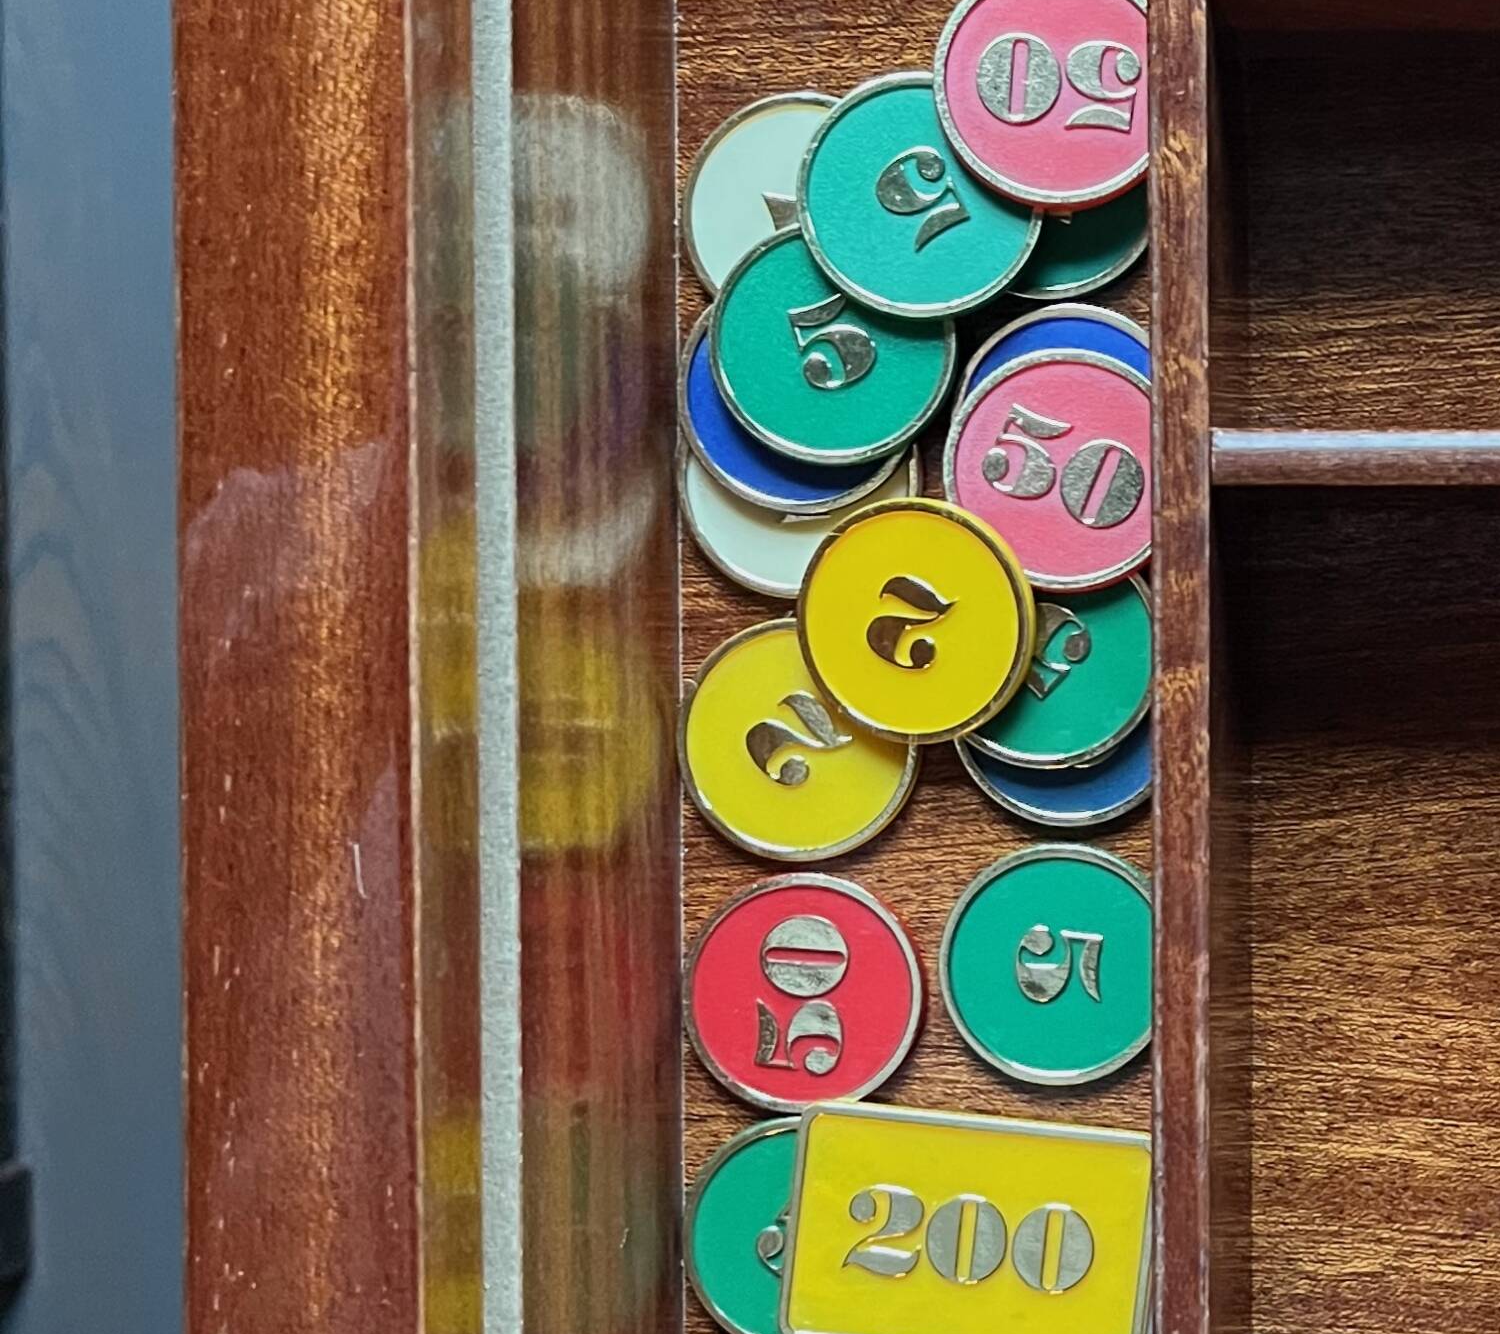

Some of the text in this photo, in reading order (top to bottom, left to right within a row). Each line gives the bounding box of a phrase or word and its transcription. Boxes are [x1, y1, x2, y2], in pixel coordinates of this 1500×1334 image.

[977, 32, 1141, 134] 50
[876, 145, 970, 253] 5
[788, 294, 877, 390] 5
[983, 403, 1145, 529] 50
[866, 575, 959, 670] 2
[745, 690, 853, 787] 2
[754, 914, 849, 1075] 50
[1015, 924, 1104, 1003] 5
[842, 1184, 1095, 1294] 200
